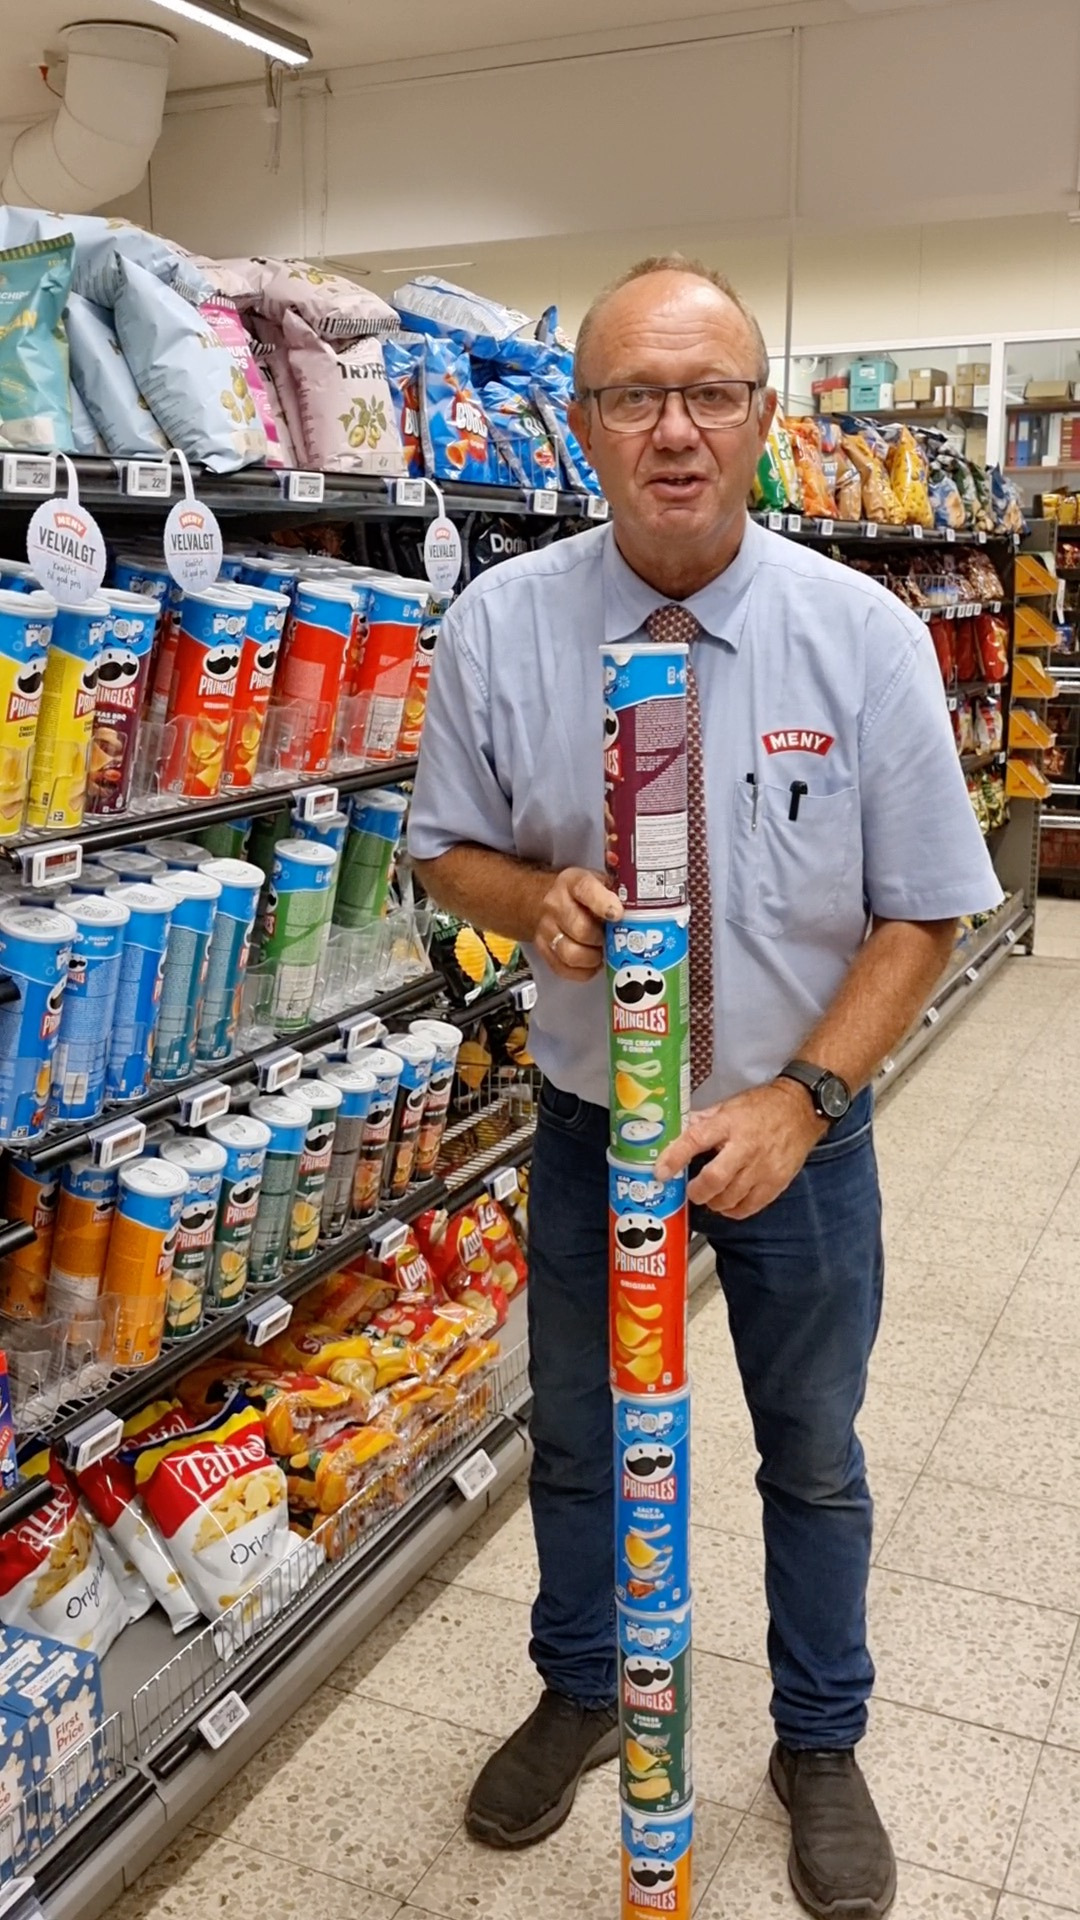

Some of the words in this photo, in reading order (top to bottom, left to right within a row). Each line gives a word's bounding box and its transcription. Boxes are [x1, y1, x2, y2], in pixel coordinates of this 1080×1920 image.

[39, 526, 97, 566] VELVALGT
[171, 533, 214, 551] VELVALGT
[769, 732, 827, 750] MENY
[614, 929, 663, 953] POP
[613, 1005, 666, 1033] PRINGLES
[617, 1037, 634, 1045] SOUR
[635, 1039, 661, 1047] CREAM
[617, 1180, 664, 1203] POP
[645, 1199, 660, 1207] PLAY
[615, 1247, 666, 1277] PRINGLES
[621, 1279, 656, 1290] ORIGINAL
[626, 1411, 673, 1433] POP
[624, 1475, 676, 1501] PRINGLES
[636, 1506, 654, 1514] SALT
[626, 1626, 671, 1648] POP
[624, 1681, 673, 1711] PRINGLES
[55, 1711, 80, 1739] First
[57, 1722, 85, 1751] Price
[631, 1830, 676, 1850] POP
[628, 1881, 677, 1912] PRINGLES
